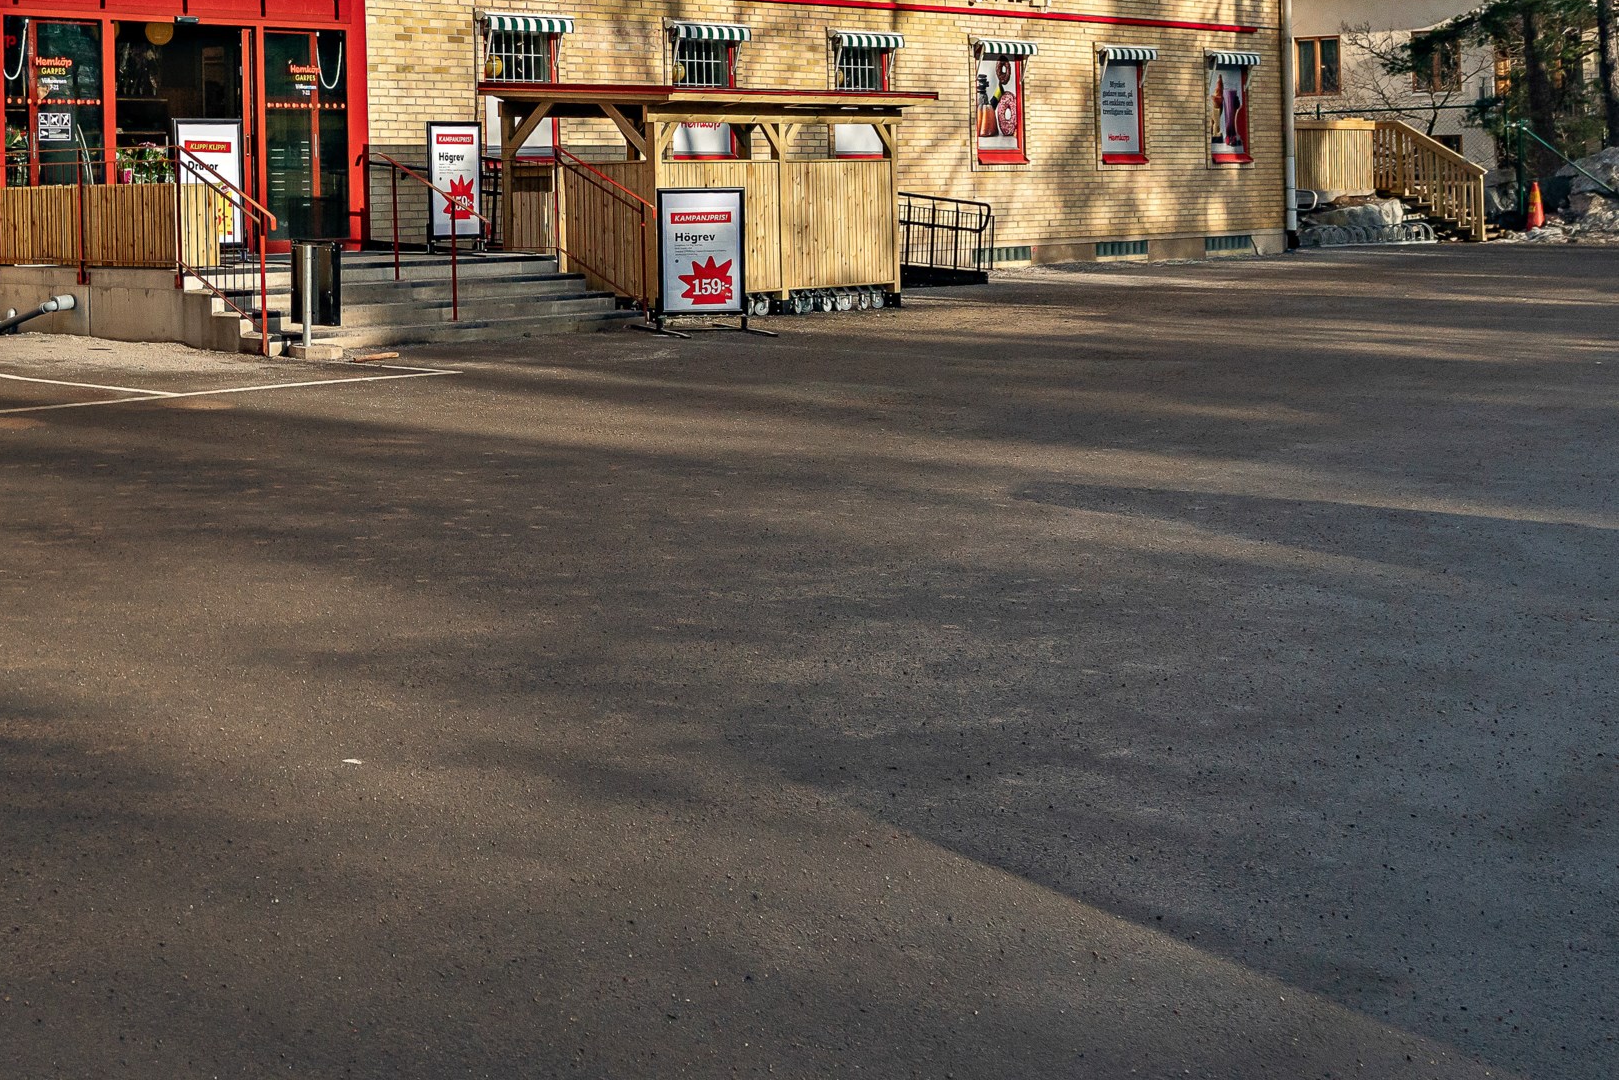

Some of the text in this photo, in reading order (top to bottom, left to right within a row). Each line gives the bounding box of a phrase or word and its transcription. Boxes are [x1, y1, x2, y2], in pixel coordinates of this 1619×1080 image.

[35, 56, 73, 68] Hemköp
[41, 67, 66, 75] GARPES
[289, 64, 321, 75] Hemköp
[438, 152, 465, 163] Högrev
[187, 160, 219, 171] Druor
[674, 214, 728, 222] KAMPANJPRIS!
[674, 232, 716, 244] Högrev
[692, 278, 730, 295] 159:-
